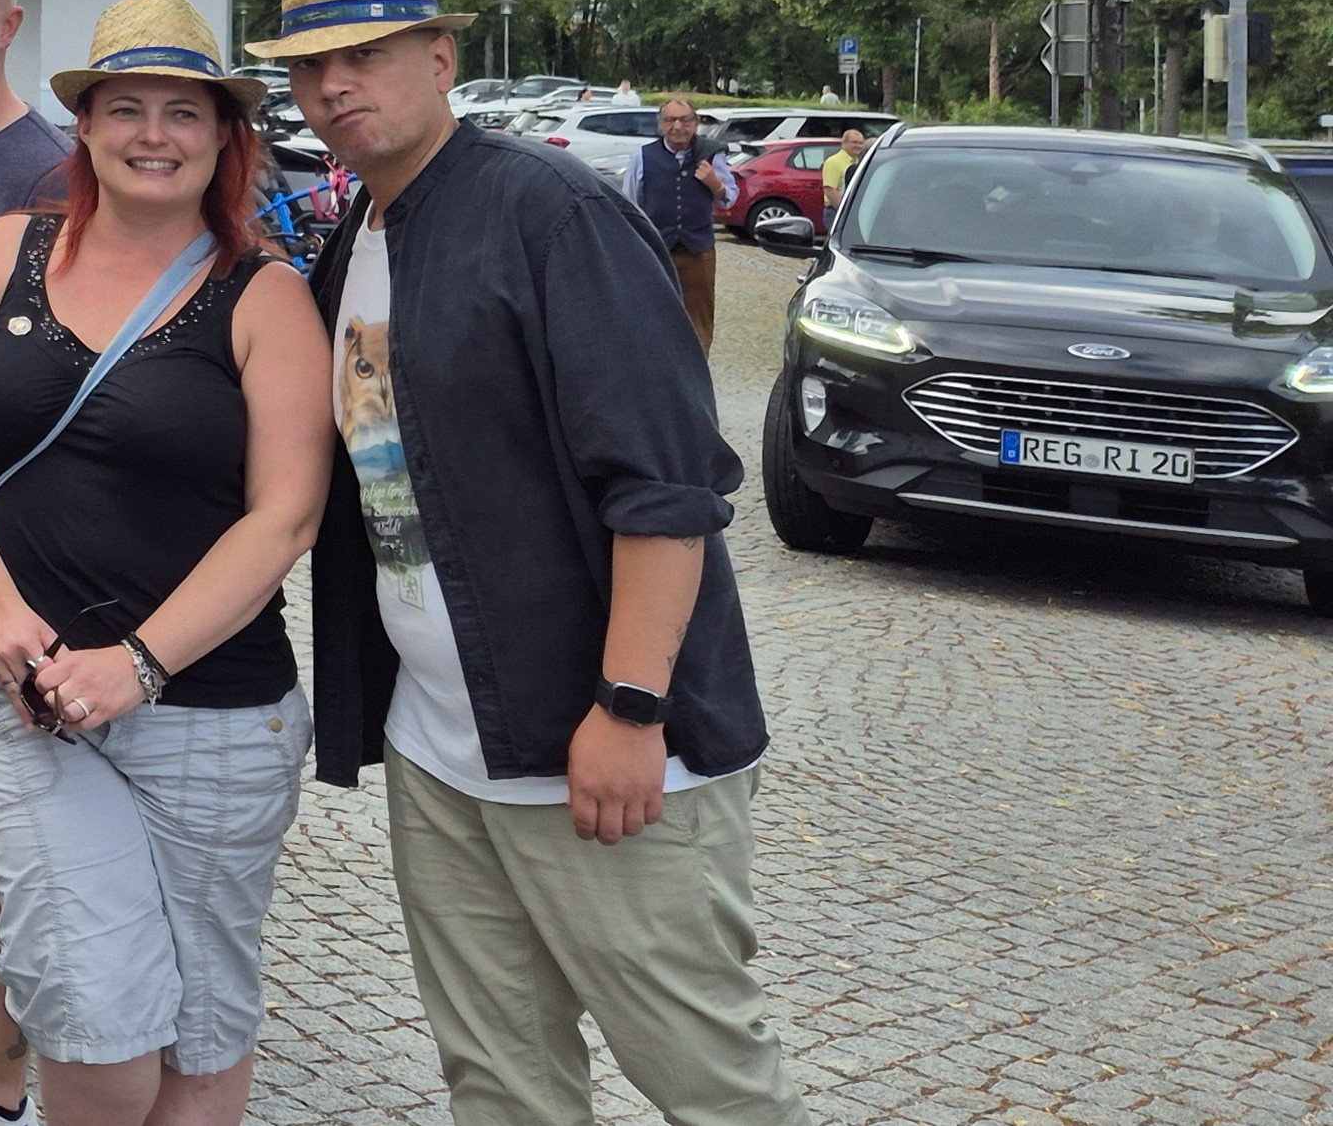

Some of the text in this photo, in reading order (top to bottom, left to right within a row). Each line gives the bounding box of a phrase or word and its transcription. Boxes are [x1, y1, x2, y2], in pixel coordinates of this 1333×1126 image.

[844, 39, 854, 53] P
[1022, 437, 1082, 467] REG
[1104, 446, 1142, 473] RI
[1151, 451, 1189, 478] 20
